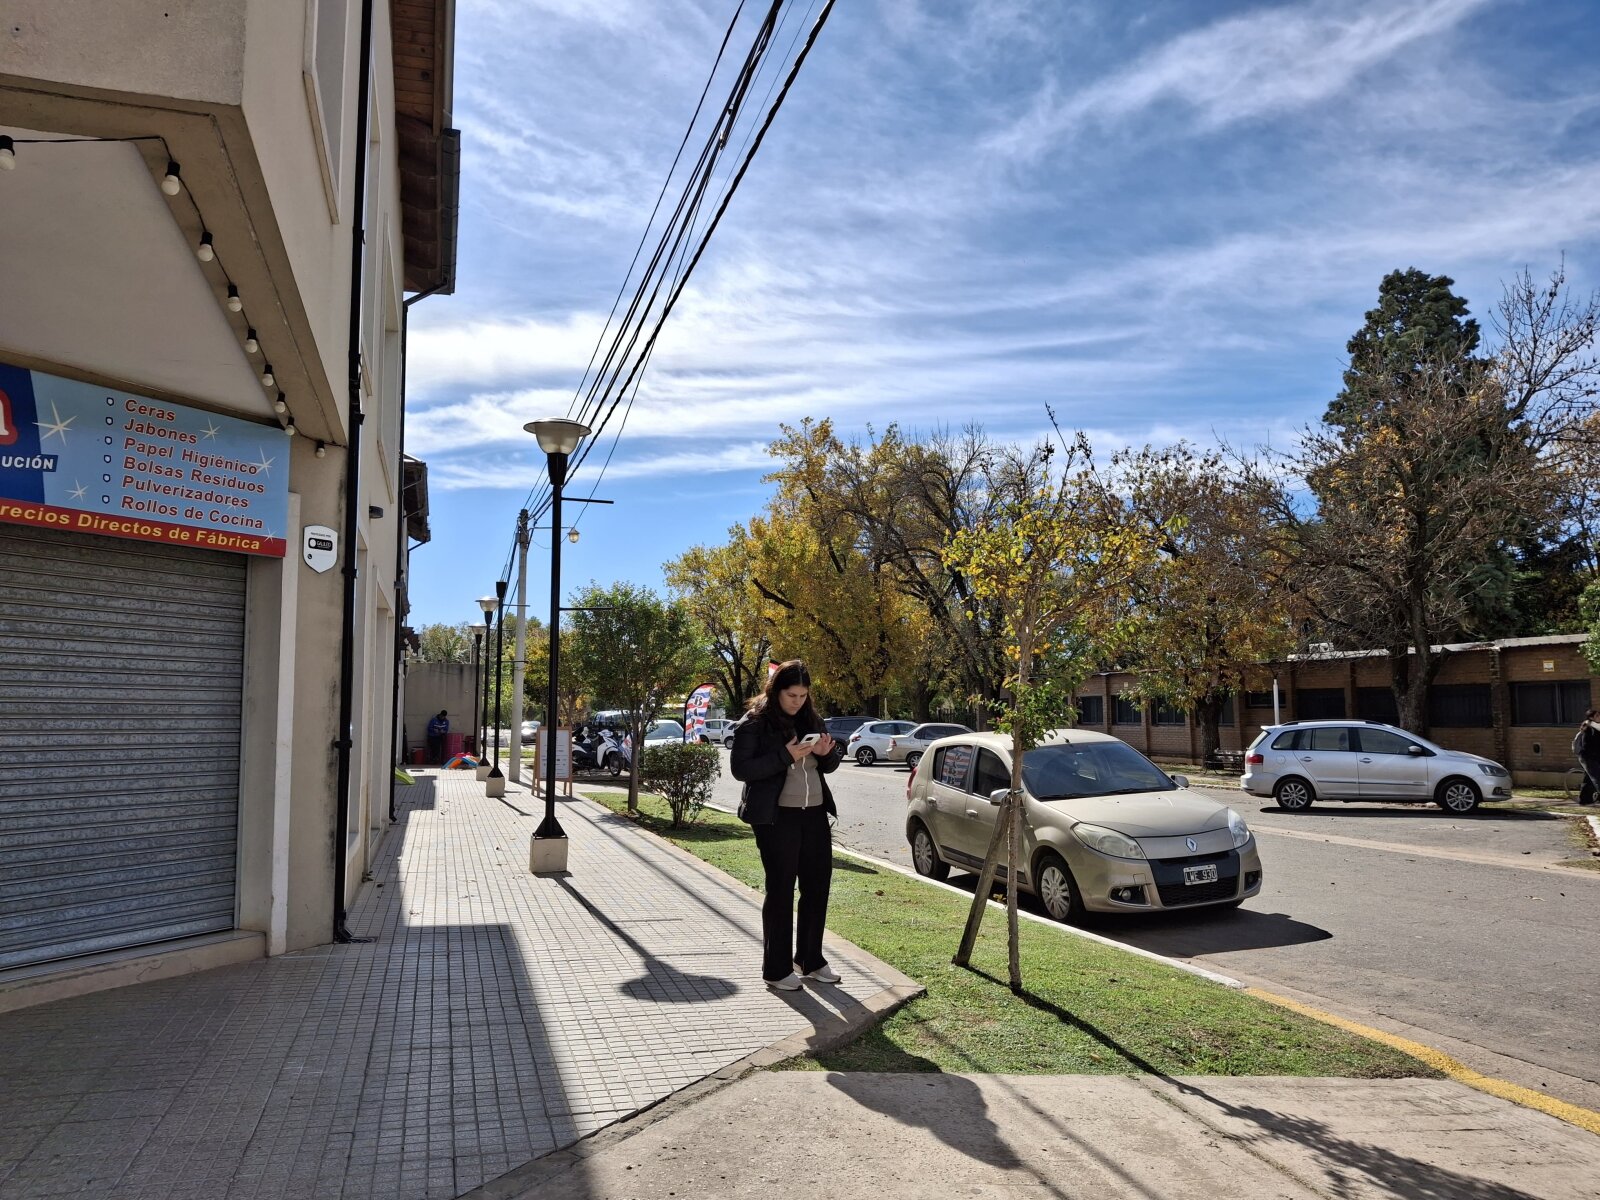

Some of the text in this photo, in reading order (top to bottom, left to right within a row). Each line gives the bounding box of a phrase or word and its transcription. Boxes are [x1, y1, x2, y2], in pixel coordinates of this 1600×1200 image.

[125, 399, 176, 421] Ceras
[124, 418, 197, 444] Jabones
[124, 437, 258, 475] Papel Higiénico
[122, 475, 249, 508] Pulverizadores
[123, 456, 265, 494] Bolsas Residuos
[121, 495, 263, 529] Rollos de Cocina
[77, 513, 162, 537] Directos
[168, 527, 190, 541] de
[196, 530, 260, 550] Fábrica
[1185, 869, 1217, 883] LWE 930
